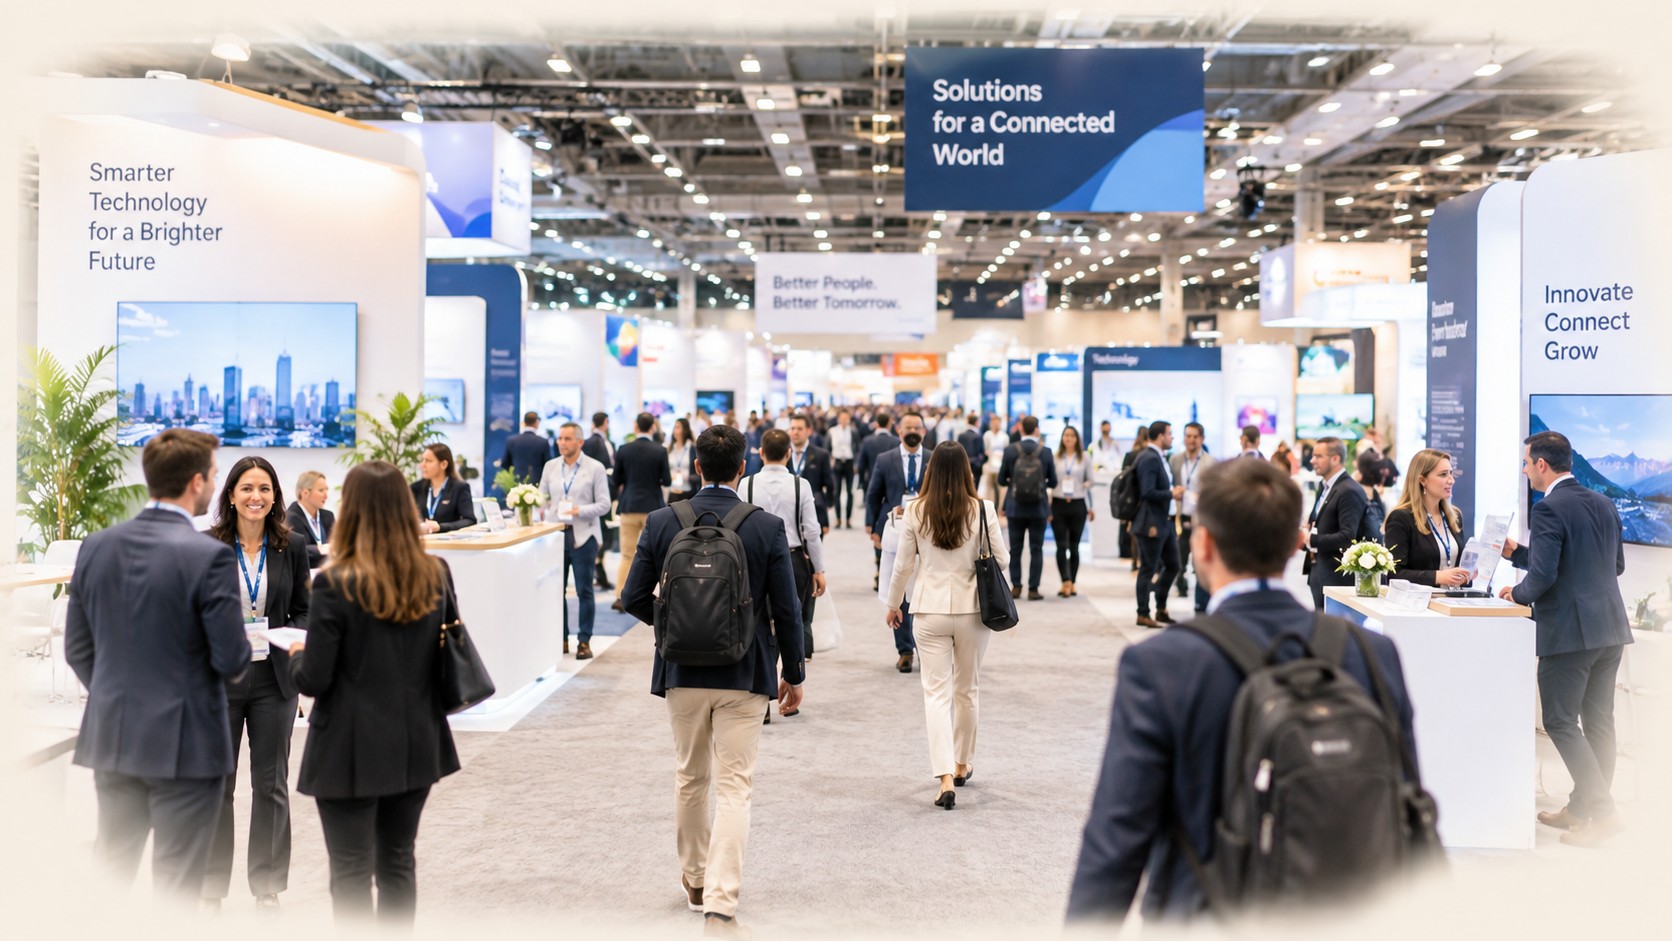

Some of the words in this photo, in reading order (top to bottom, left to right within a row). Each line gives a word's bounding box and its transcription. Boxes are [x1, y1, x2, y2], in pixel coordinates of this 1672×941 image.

[932, 78, 1043, 102] Solutions
[932, 110, 966, 133] for
[970, 115, 985, 133] a
[989, 110, 1115, 133] Connected
[932, 143, 1004, 165] World
[89, 162, 175, 182] Smarter
[89, 192, 207, 217] Technology
[88, 221, 117, 241] for
[122, 226, 134, 241] a
[141, 222, 223, 246] Brighter
[89, 251, 156, 270] Future
[773, 276, 818, 290] Better
[823, 276, 878, 292] People.
[1545, 283, 1634, 304] Innovate
[773, 296, 818, 310] Better
[824, 296, 902, 310] Tomorrow.
[1545, 312, 1631, 332] Connect
[1545, 341, 1599, 361] Grow
